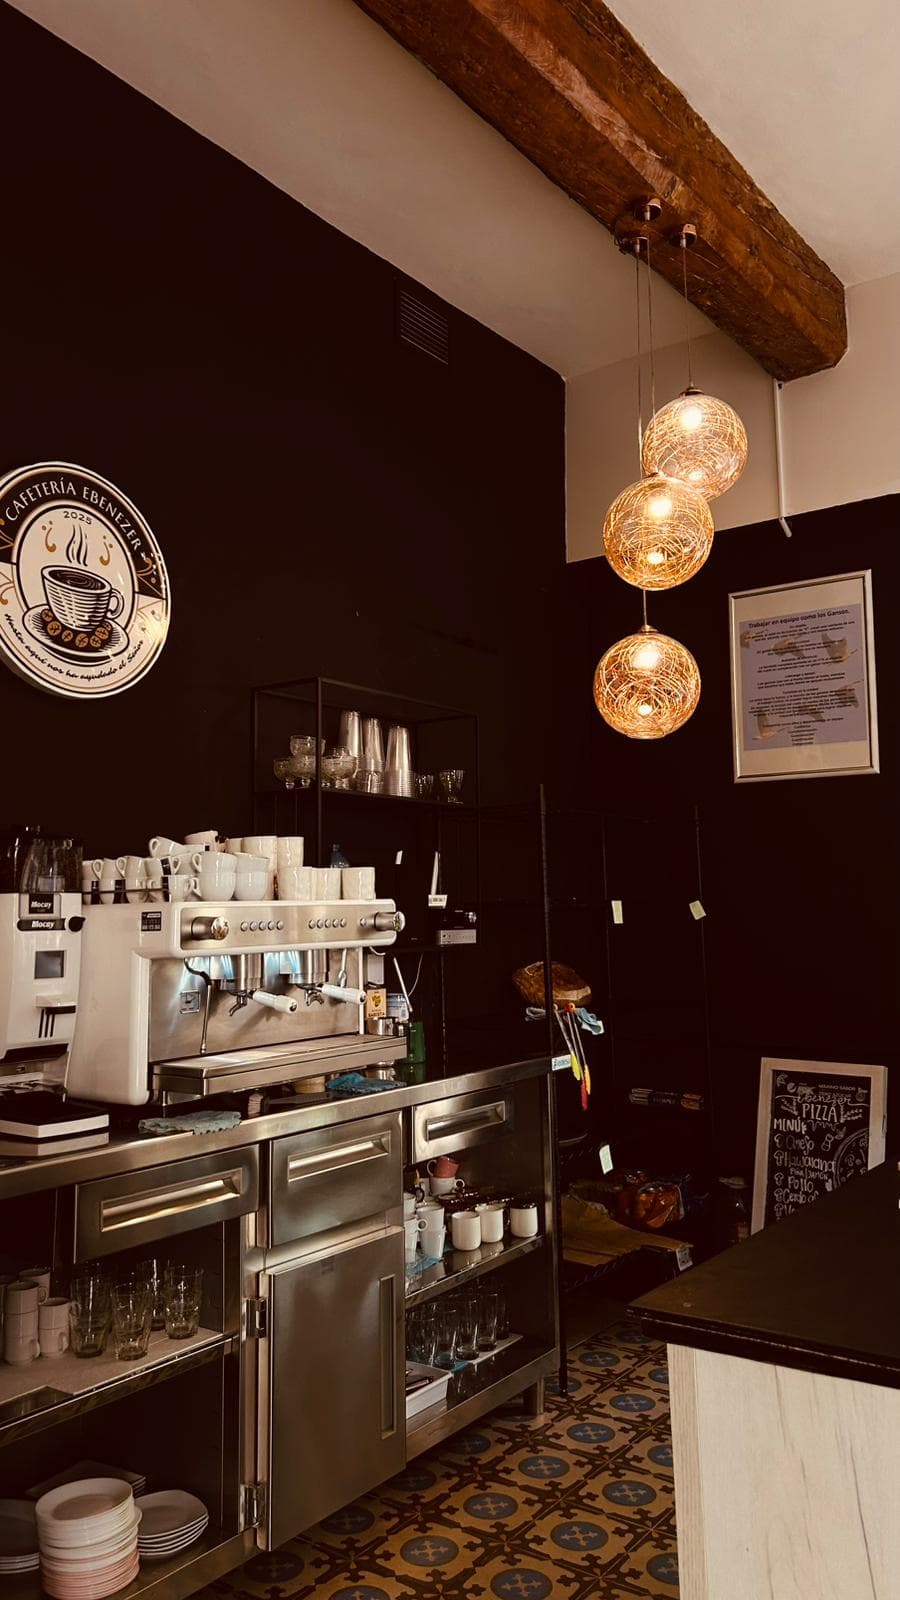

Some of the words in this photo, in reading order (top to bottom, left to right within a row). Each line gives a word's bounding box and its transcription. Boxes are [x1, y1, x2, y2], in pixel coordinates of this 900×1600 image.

[5, 478, 77, 521] CAFETERÍA
[82, 486, 142, 551] EBENEZER
[63, 510, 92, 525] 2025
[748, 619, 771, 629] Trabajar
[780, 616, 799, 625] equipo
[47, 663, 64, 674] nos
[30, 900, 52, 910] Mocay
[31, 920, 55, 929] Mocay
[801, 1103, 838, 1122] PIZZA
[788, 1175, 814, 1193] Pollo
